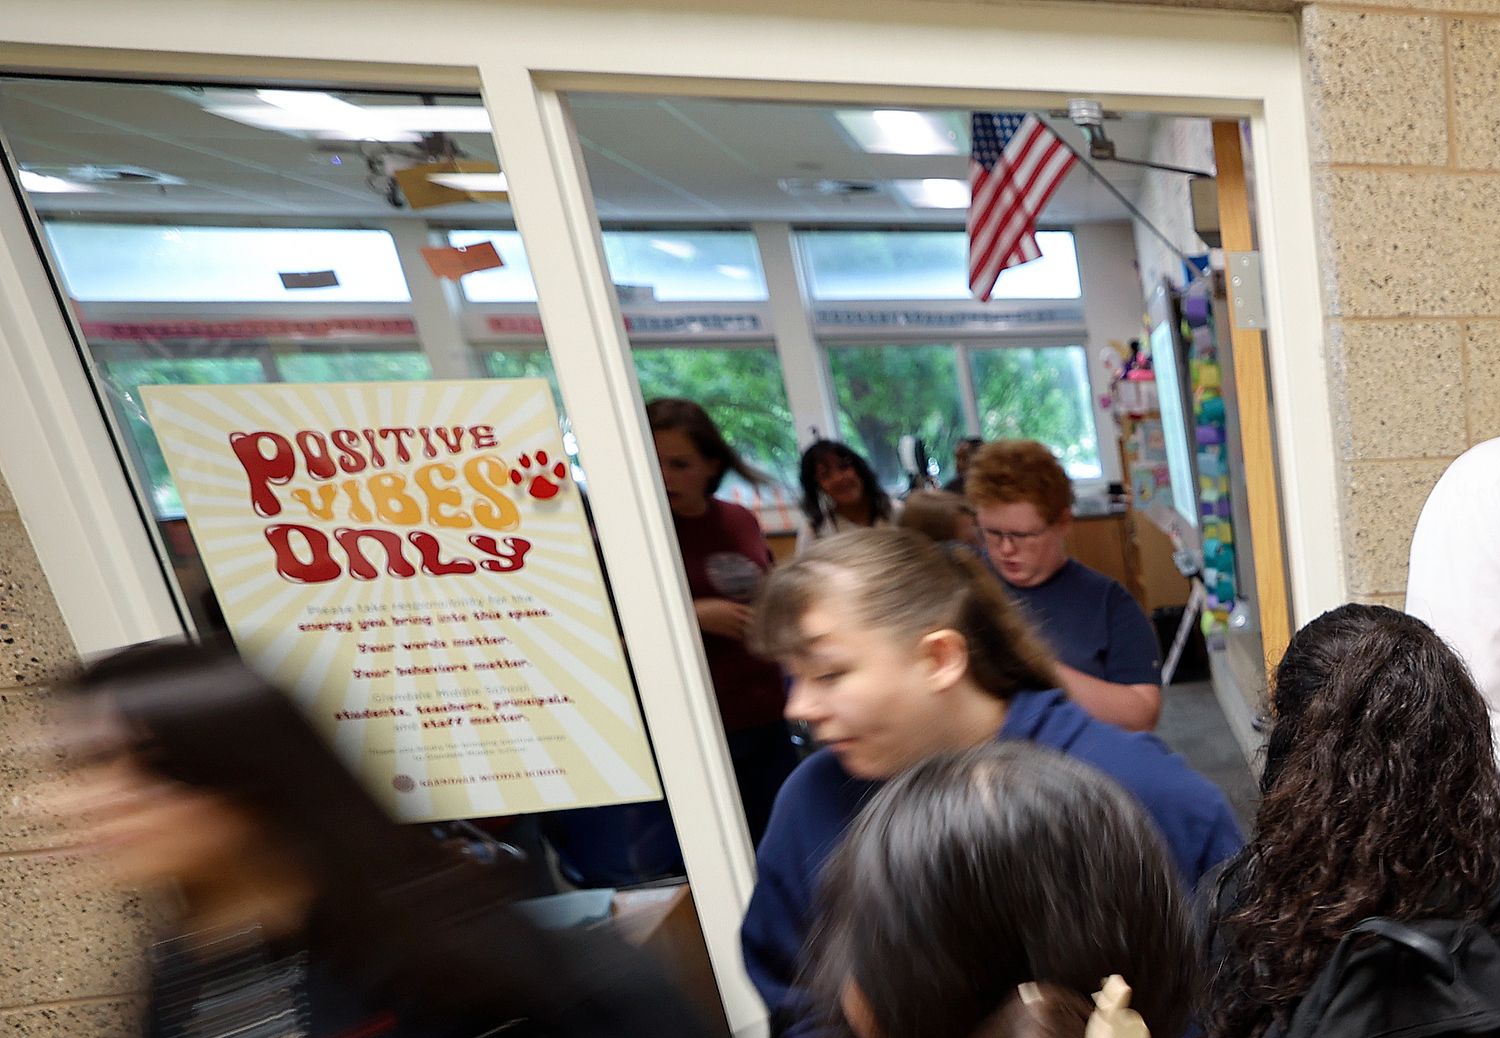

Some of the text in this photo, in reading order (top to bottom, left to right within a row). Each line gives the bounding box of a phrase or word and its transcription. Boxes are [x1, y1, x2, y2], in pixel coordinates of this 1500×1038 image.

[229, 425, 499, 518] POSITIVE
[291, 455, 521, 532] VIBES
[264, 523, 532, 584] ONLY
[357, 642, 395, 654] Your
[403, 639, 447, 650] words
[353, 668, 391, 680] Your
[422, 717, 464, 730] staff
